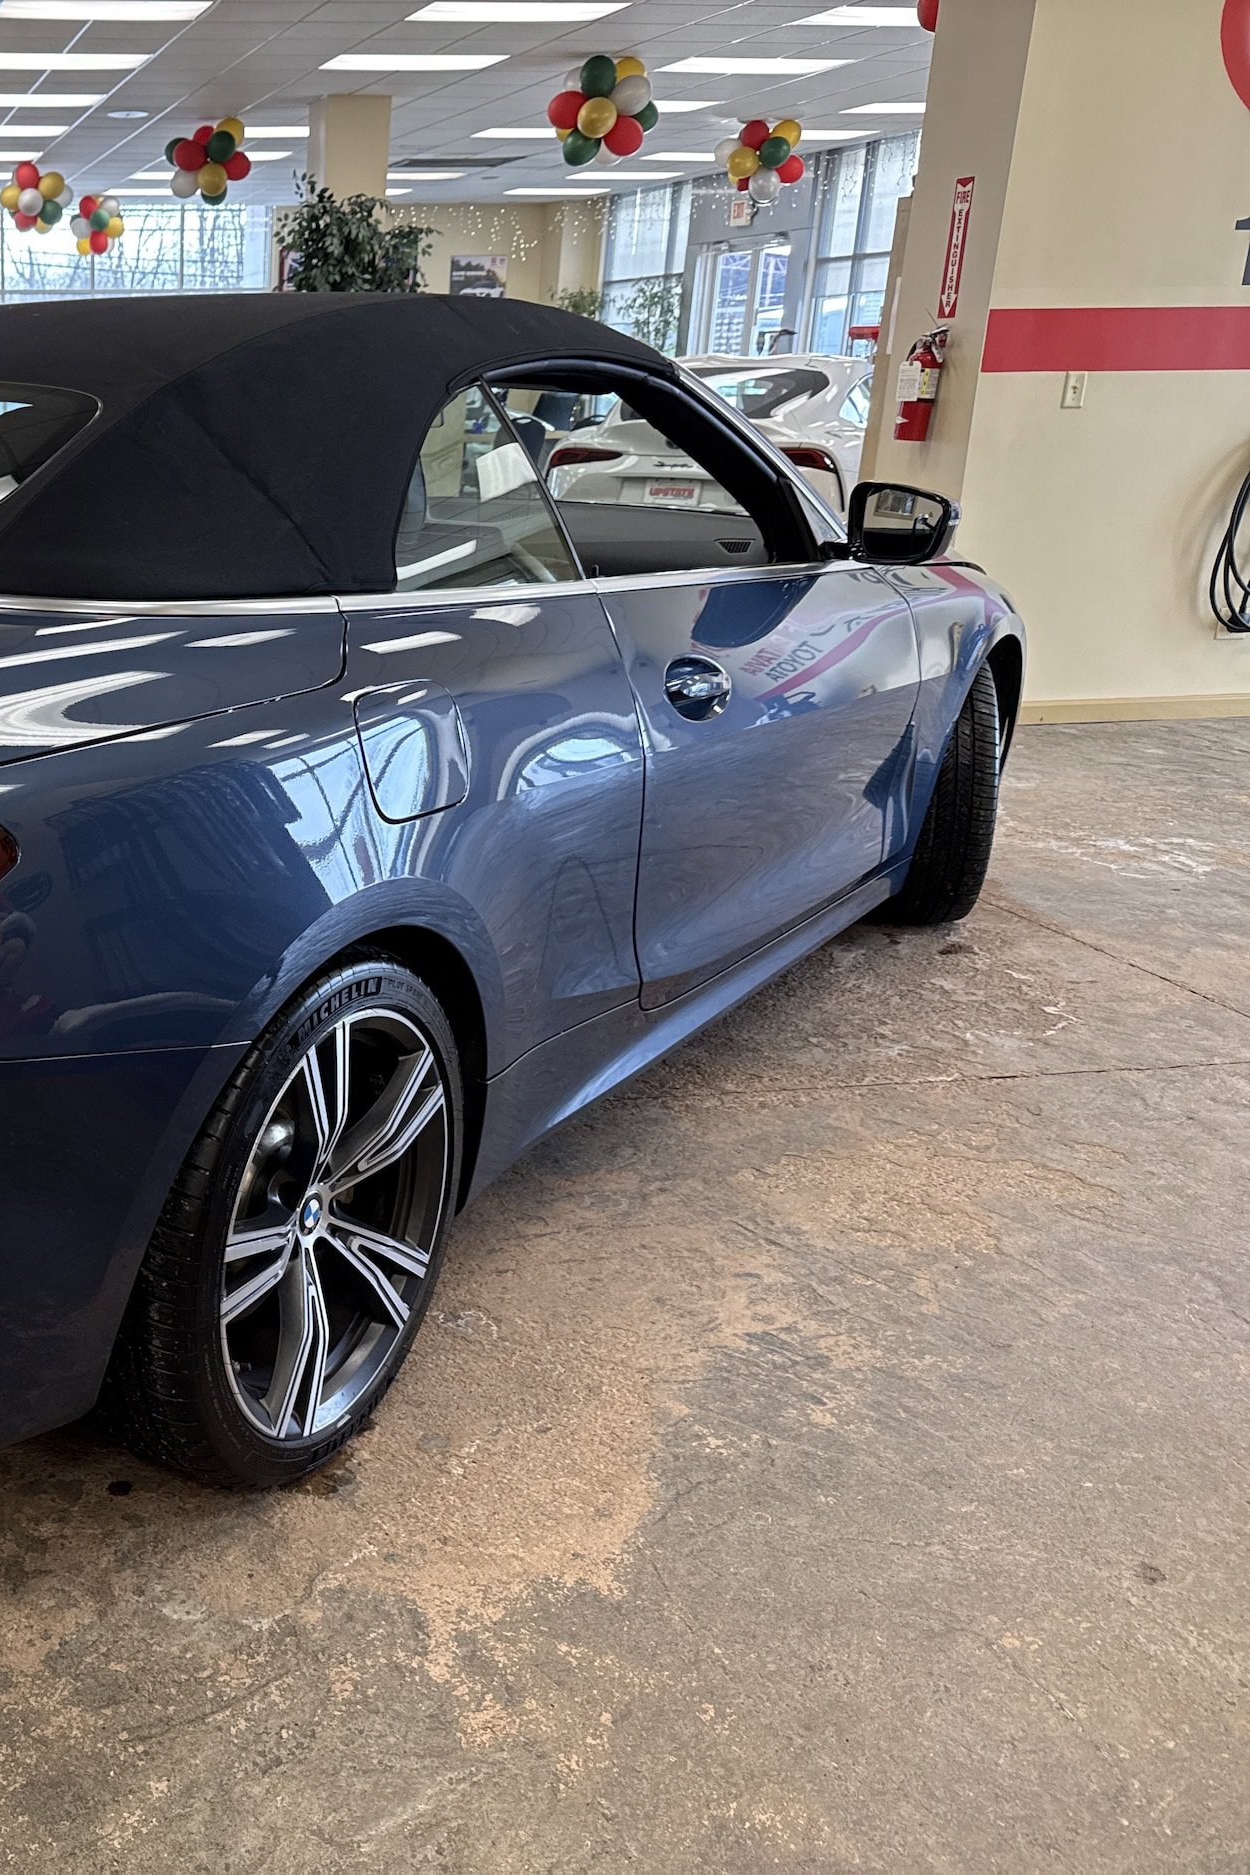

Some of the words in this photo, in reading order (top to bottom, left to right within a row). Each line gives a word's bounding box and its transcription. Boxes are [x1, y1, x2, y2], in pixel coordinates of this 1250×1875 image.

[956, 190, 971, 204] FIRE
[945, 208, 965, 308] EXTINGUISHER
[296, 977, 380, 1041] MICHELIN
